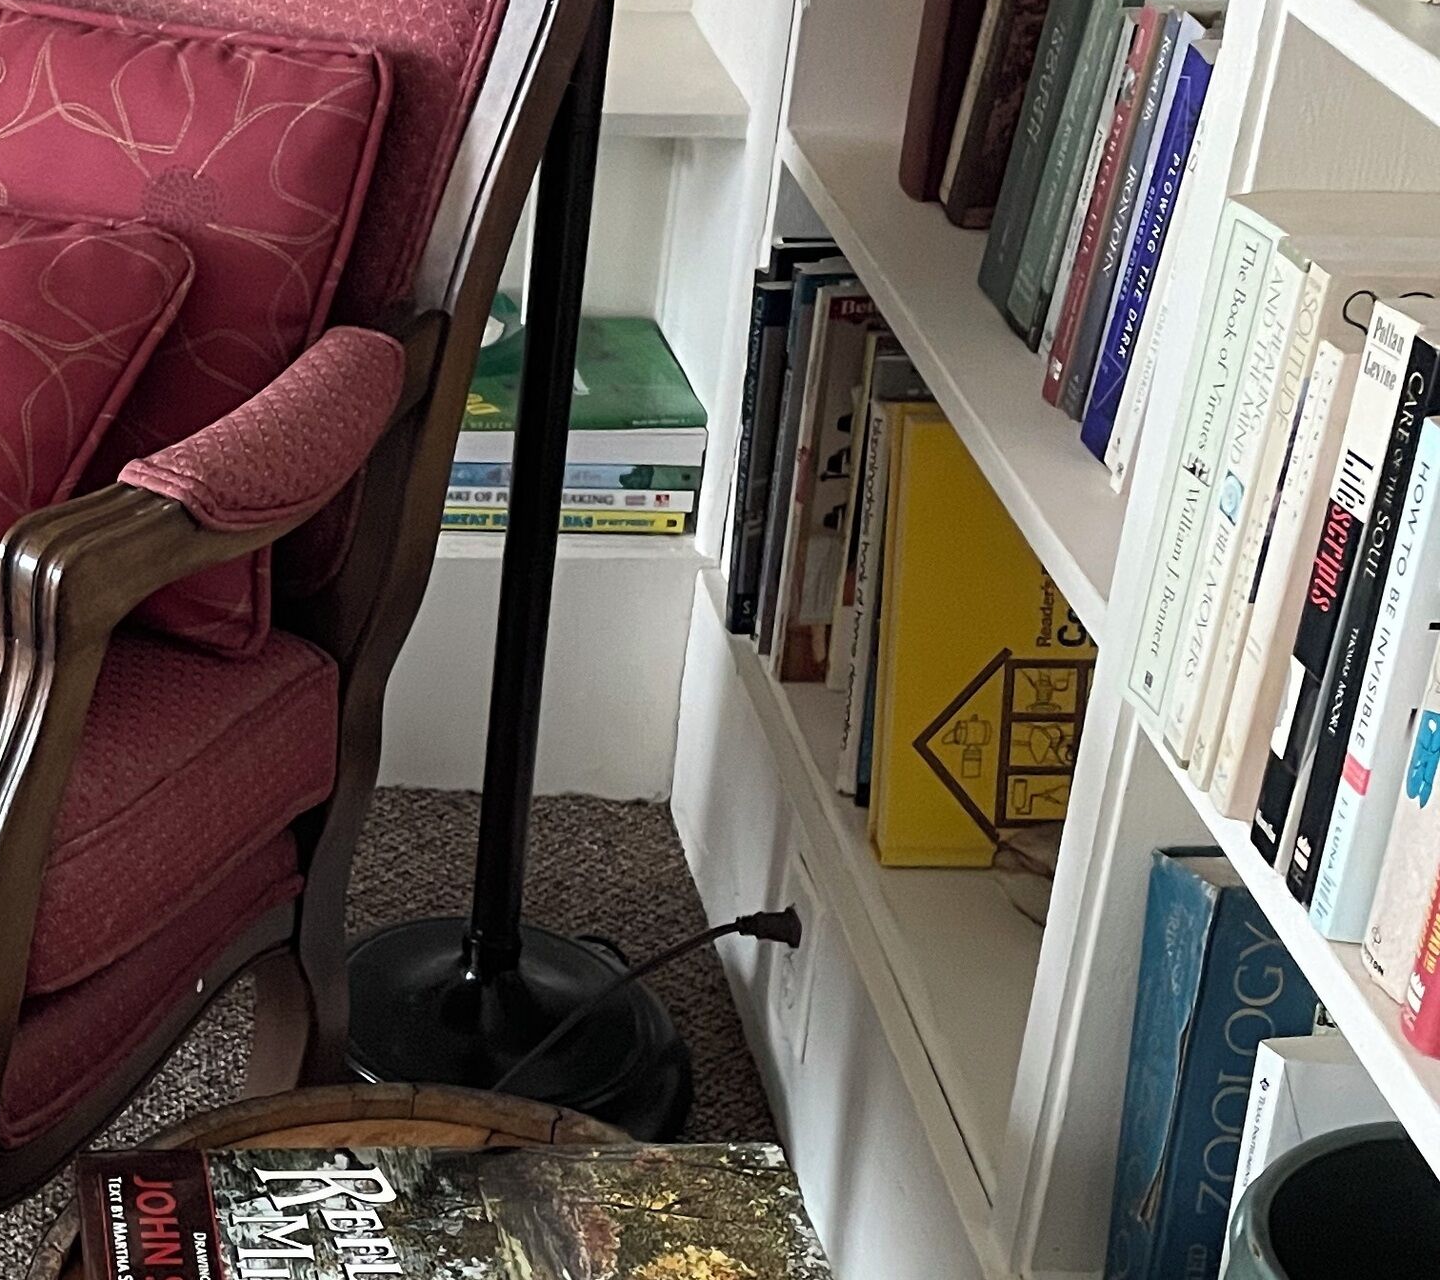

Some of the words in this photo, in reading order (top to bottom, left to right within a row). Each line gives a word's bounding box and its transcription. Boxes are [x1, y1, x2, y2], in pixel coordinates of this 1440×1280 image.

[1117, 163, 1138, 221] IRON
[1133, 186, 1156, 247] RICHARD
[1146, 152, 1182, 253] PLOWING
[1103, 221, 1127, 278] JOHN
[1238, 241, 1260, 282] The
[1133, 264, 1151, 303] THE
[1262, 266, 1285, 329] AND
[1116, 308, 1139, 359] DARK
[1222, 287, 1248, 341] Book
[1371, 315, 1406, 358] Pollan
[1134, 353, 1158, 415] MORGAN
[1216, 347, 1229, 379] of
[1249, 339, 1269, 384] THE
[1251, 320, 1287, 433] HEALING
[1274, 294, 1319, 434] SOLITUDE
[1362, 349, 1398, 391] Levine
[1197, 382, 1226, 451] Virtues
[1230, 391, 1255, 466] MIND
[1394, 370, 1426, 447] CARE
[475, 491, 493, 503] OF
[1382, 469, 1401, 507] THE
[1406, 459, 1431, 535] HOW
[1171, 487, 1201, 559] William
[1213, 522, 1231, 567] BILL
[1361, 509, 1391, 581] SOUL
[1394, 543, 1413, 577] TO
[1035, 577, 1056, 648] Reader's
[1151, 584, 1177, 658] Bennett
[1184, 570, 1217, 680] MOYERS
[1385, 586, 1401, 620] BE
[1339, 626, 1361, 678] THOMAS
[1326, 679, 1348, 737] MOORE
[1354, 625, 1393, 749] INVISIBLE
[1326, 827, 1343, 870] LUNA
[1254, 1094, 1267, 1124] TEXAS
[1242, 1124, 1260, 1188] INSTRUMENTS
[107, 1175, 123, 1203] TEXT
[110, 1204, 126, 1224] BY
[112, 1221, 131, 1273] MARTHA
[132, 1173, 184, 1265] JOHN
